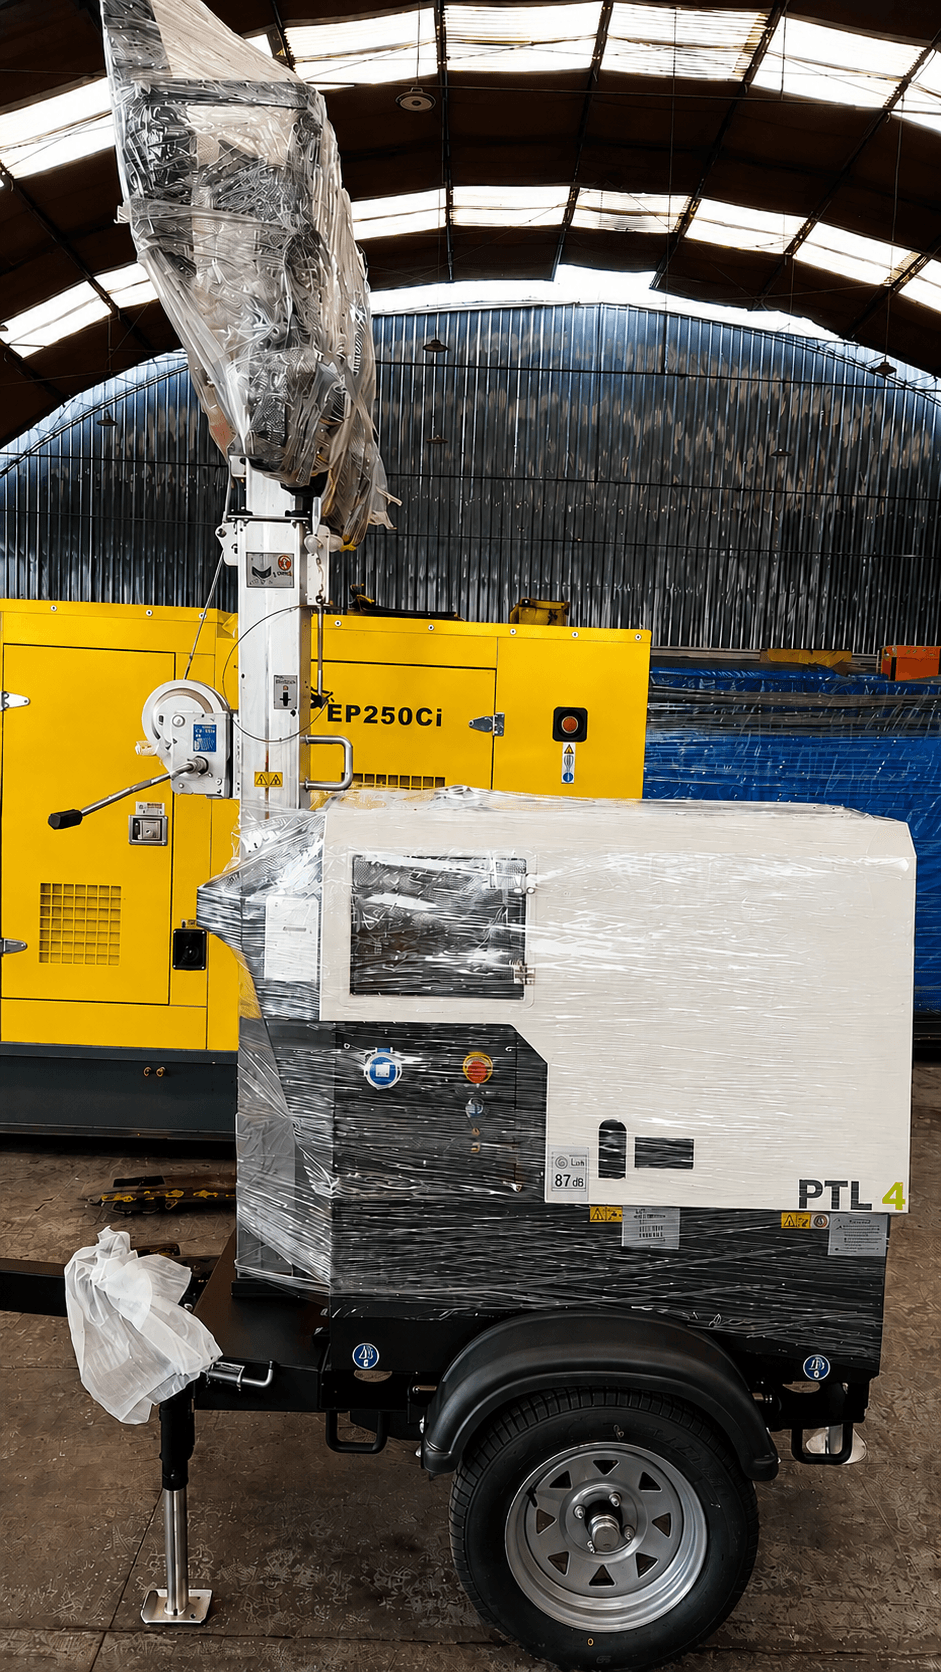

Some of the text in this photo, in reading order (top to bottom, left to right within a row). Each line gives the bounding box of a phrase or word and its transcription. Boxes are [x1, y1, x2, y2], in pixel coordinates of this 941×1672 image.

[327, 704, 442, 727] EP250Ci
[555, 1173, 571, 1187] 87
[799, 1179, 906, 1210] PTL 4
